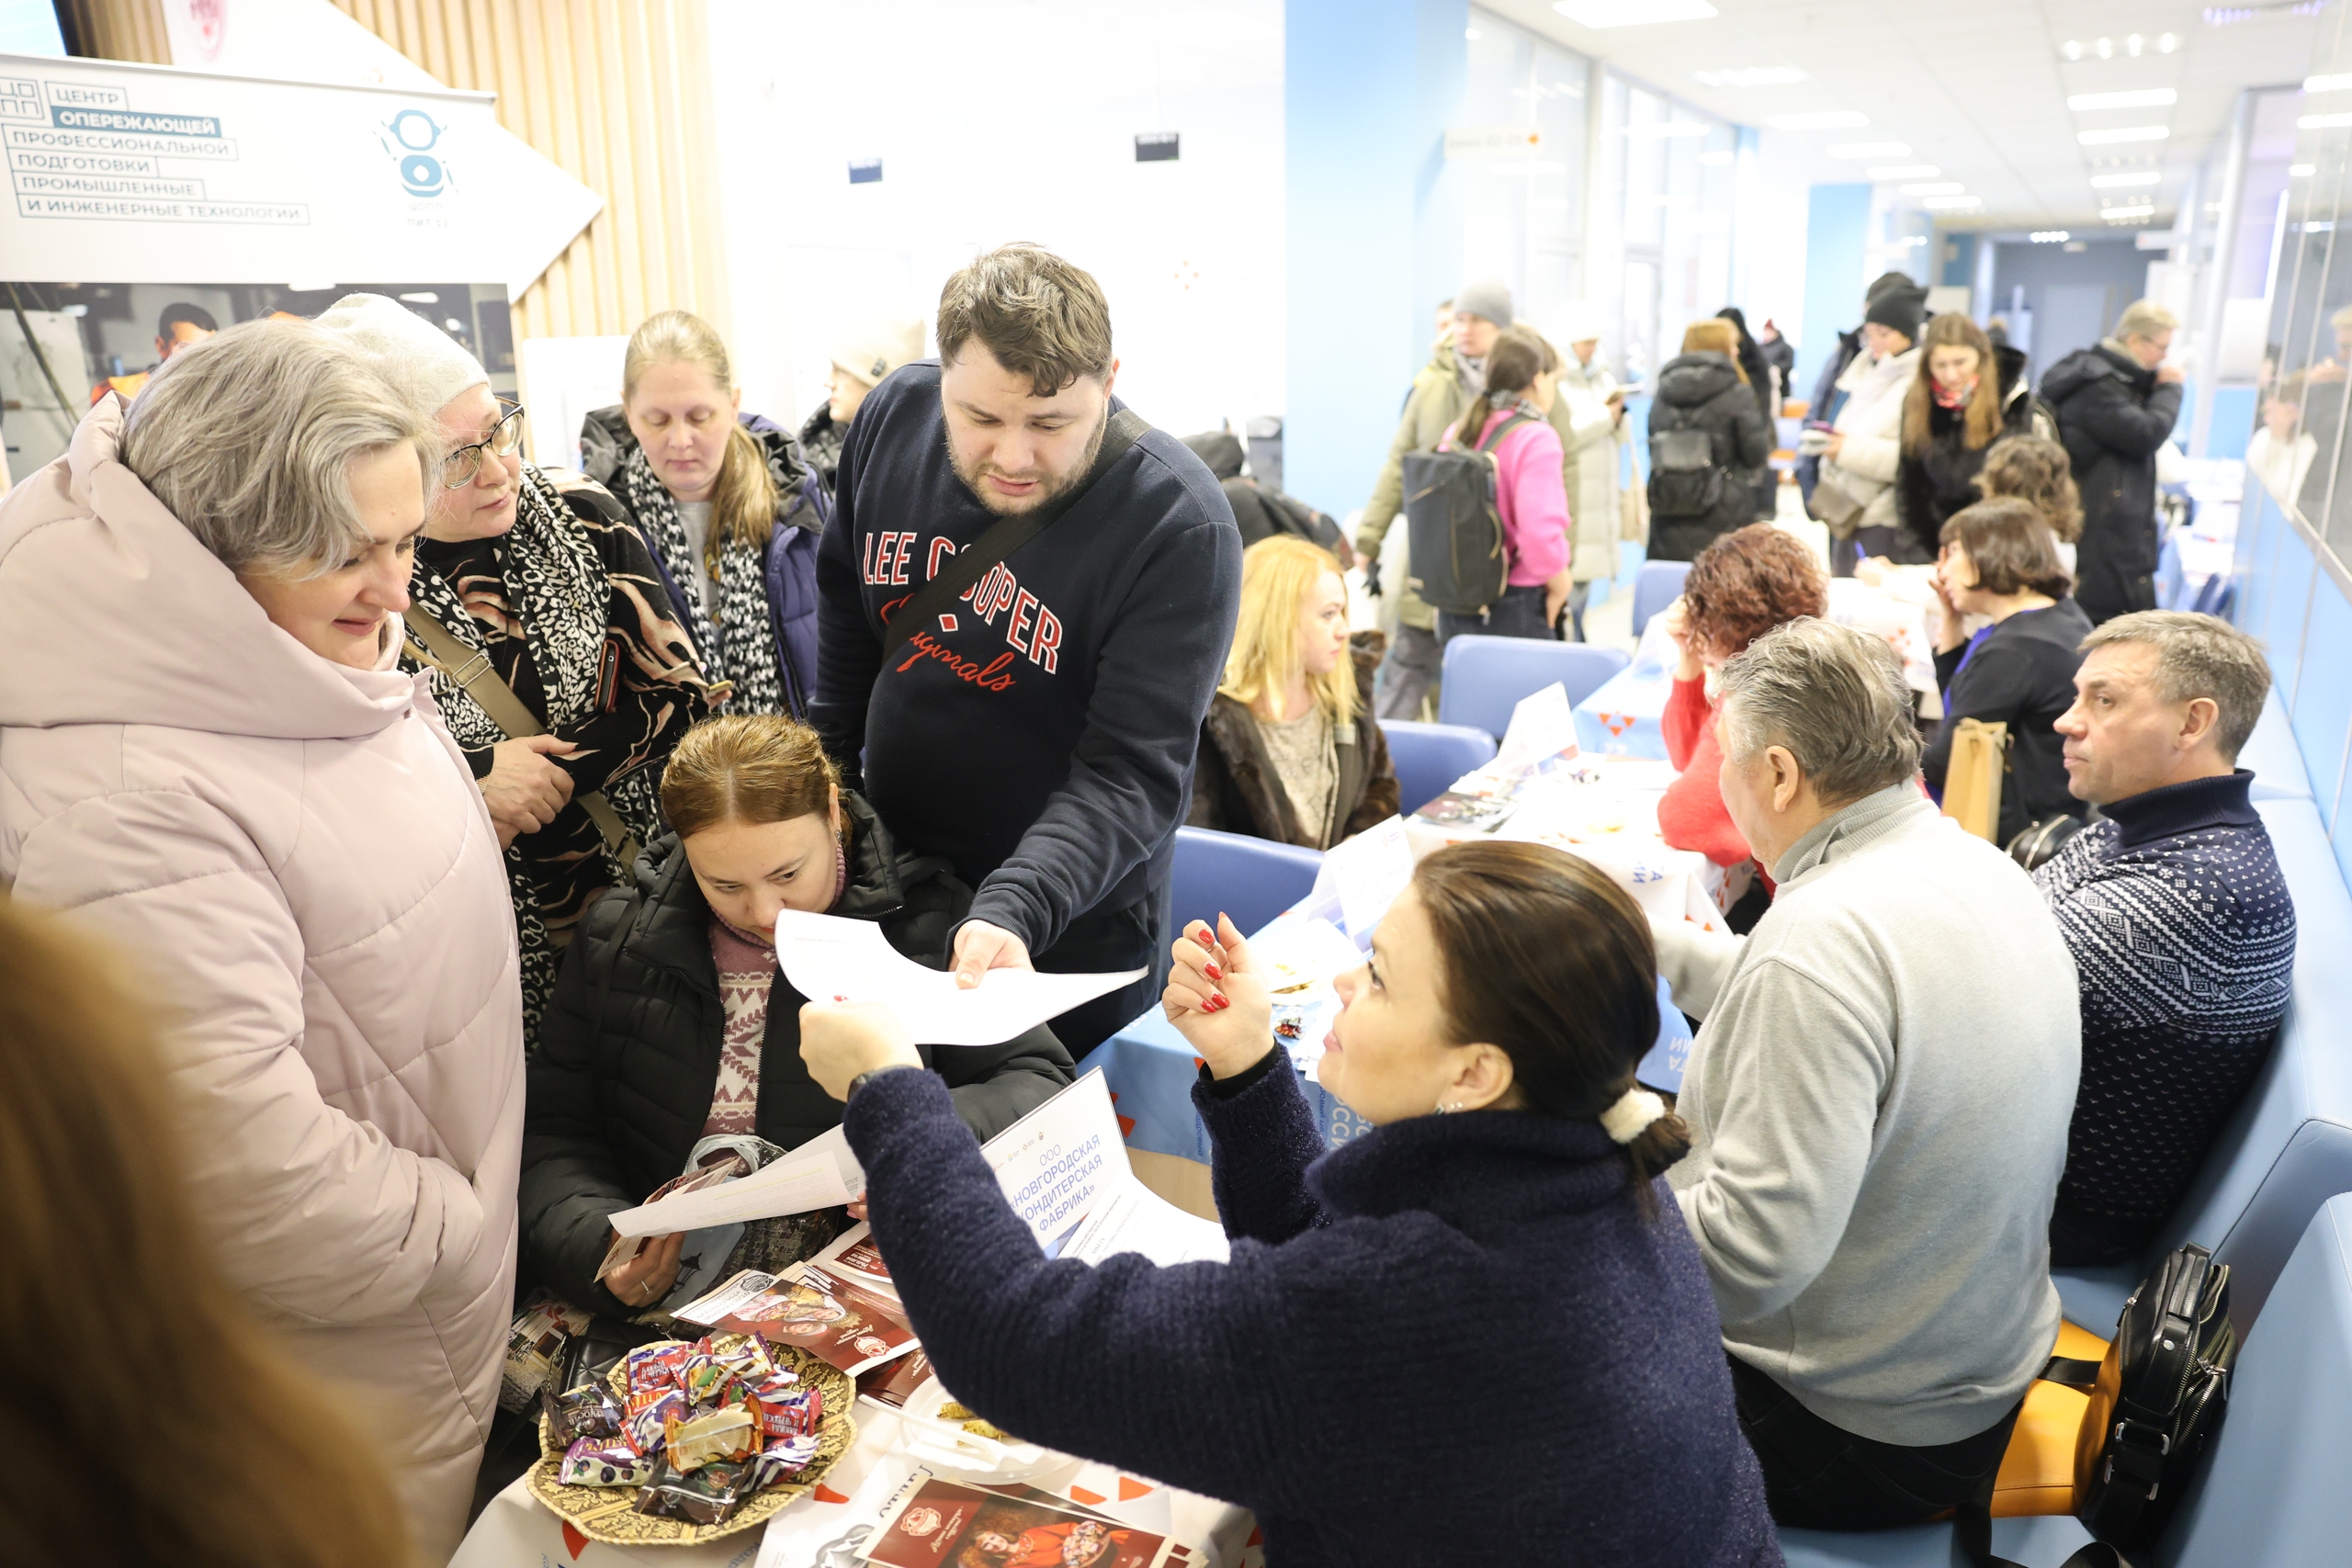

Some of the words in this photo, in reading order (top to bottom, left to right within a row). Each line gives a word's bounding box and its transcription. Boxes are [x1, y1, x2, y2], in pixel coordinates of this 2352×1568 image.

[55, 87, 119, 105] ЦЕНТР
[59, 110, 216, 136] ОПЕРЕЖАЮЩЕЙ
[13, 130, 231, 156] ПРОФЕССИОНАЛЬНОЙ
[17, 153, 151, 174] ПОДГОТОВКИ
[22, 176, 196, 197] ПРОМЫШЛЕННЫЕ
[28, 199, 41, 212] И
[47, 200, 182, 217] ИНЖЕНЕРНЫЕ
[187, 204, 300, 220] ТЕХНОЛОГИИ
[864, 531, 917, 585] LEE
[926, 536, 1063, 675] COPER
[1195, 1111, 1204, 1156] адровый
[1041, 1143, 1063, 1167] ООО
[1041, 1184, 1094, 1231] ФАБРИКА»
[1090, 1236, 1106, 1255] АНКЕТА
